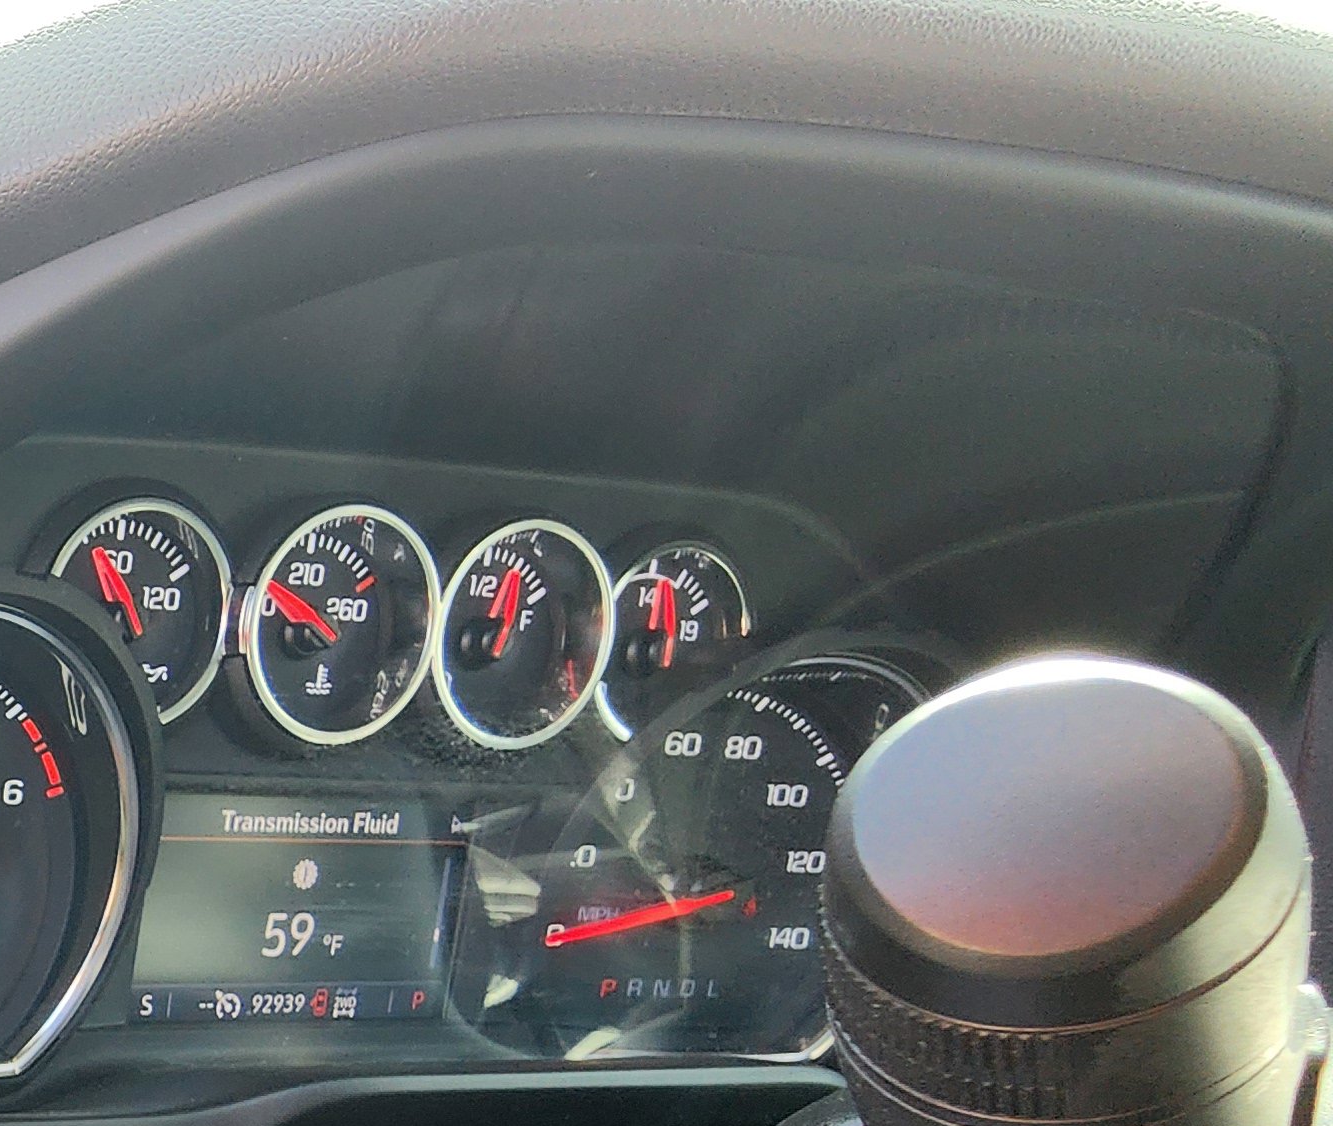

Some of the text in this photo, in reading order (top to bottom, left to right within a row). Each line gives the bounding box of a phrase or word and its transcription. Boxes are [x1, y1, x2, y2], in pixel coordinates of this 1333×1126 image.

[287, 562, 325, 587] 210
[469, 573, 497, 598] 1/2
[143, 585, 180, 611] 120
[326, 596, 369, 622] 260
[519, 610, 534, 631] F
[679, 619, 700, 641] 19
[664, 731, 703, 757] 60
[724, 735, 763, 760] 80
[2, 778, 25, 805] 6
[766, 783, 809, 808] 100
[221, 808, 400, 836] Transmission Fluid
[786, 850, 826, 874] 120
[261, 911, 316, 959] 59
[768, 926, 810, 950] 140
[599, 978, 619, 998] P
[627, 977, 643, 998] R
[653, 978, 672, 998] N
[679, 979, 696, 998] D
[139, 994, 153, 1017] S
[251, 993, 306, 1015] 92939
[412, 990, 426, 1011] P
